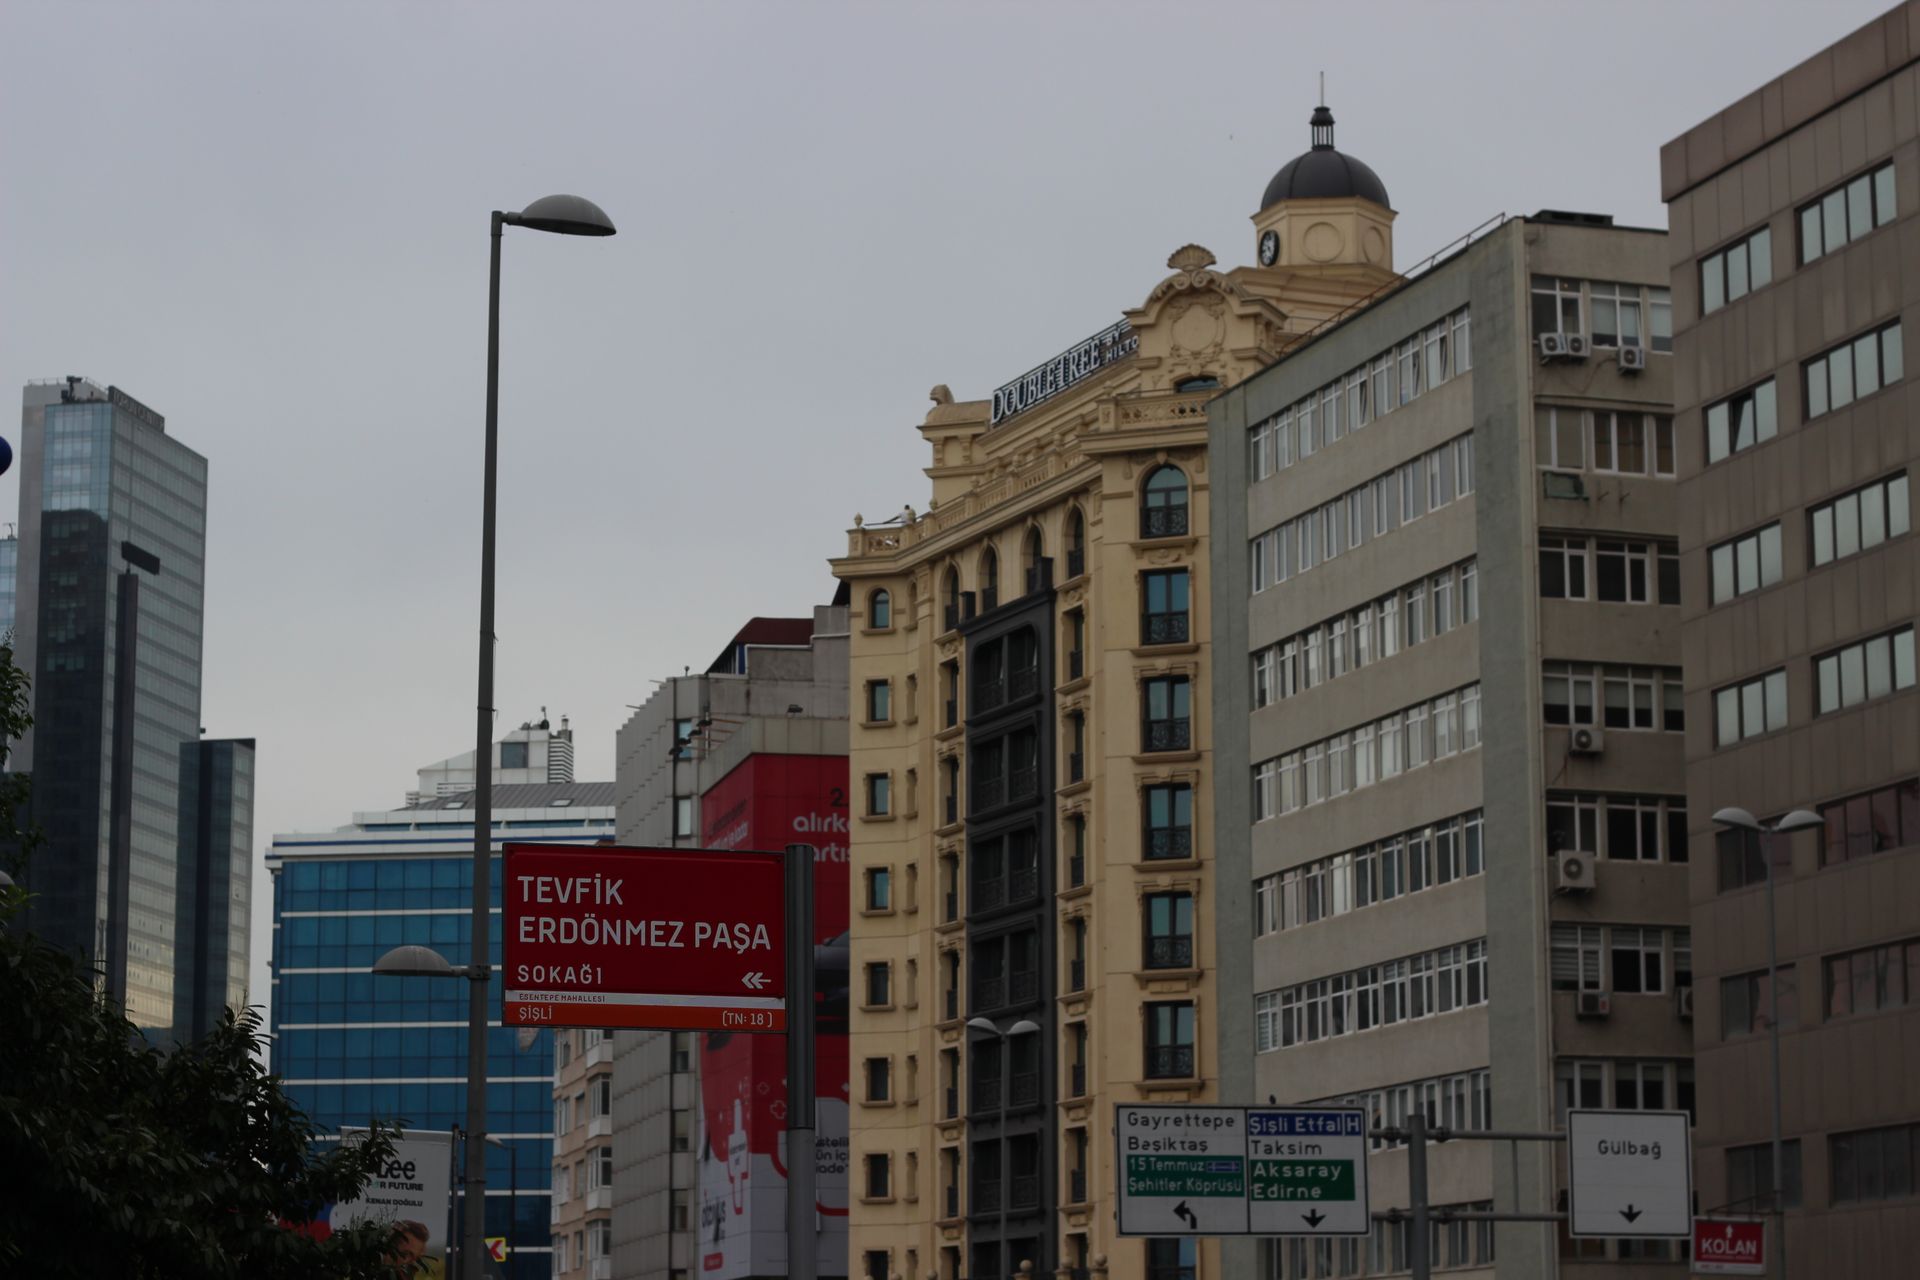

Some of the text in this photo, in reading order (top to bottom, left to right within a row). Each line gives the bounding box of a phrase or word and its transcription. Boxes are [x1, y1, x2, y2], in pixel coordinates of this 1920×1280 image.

[1106, 335, 1139, 362] HILTO
[991, 338, 1101, 424] DOUBLETREE
[517, 873, 623, 905] TEVFİK
[519, 913, 771, 954] ERDÖNMEZ PAŞA
[517, 964, 602, 984] SOKAĞI
[519, 993, 560, 1002] ESENTEPE
[519, 1005, 552, 1021] ŞİŞLİ
[1127, 1112, 1235, 1131] Gayrettepe
[1249, 1116, 1360, 1134] Şişli Etfal H
[1128, 1136, 1208, 1152] Beşiktaş
[1251, 1140, 1322, 1155] Taksim
[1598, 1139, 1661, 1160] Gülbağ
[1130, 1157, 1205, 1172] 15 Temmuz
[1253, 1161, 1342, 1181] Aksaray
[388, 1182, 424, 1191] FUTURE
[1128, 1177, 1242, 1195] Şehitler Köprüsü
[1253, 1183, 1322, 1198] Edirne
[392, 1198, 423, 1207] DOĞULU
[1701, 1238, 1757, 1255] KOLAN
